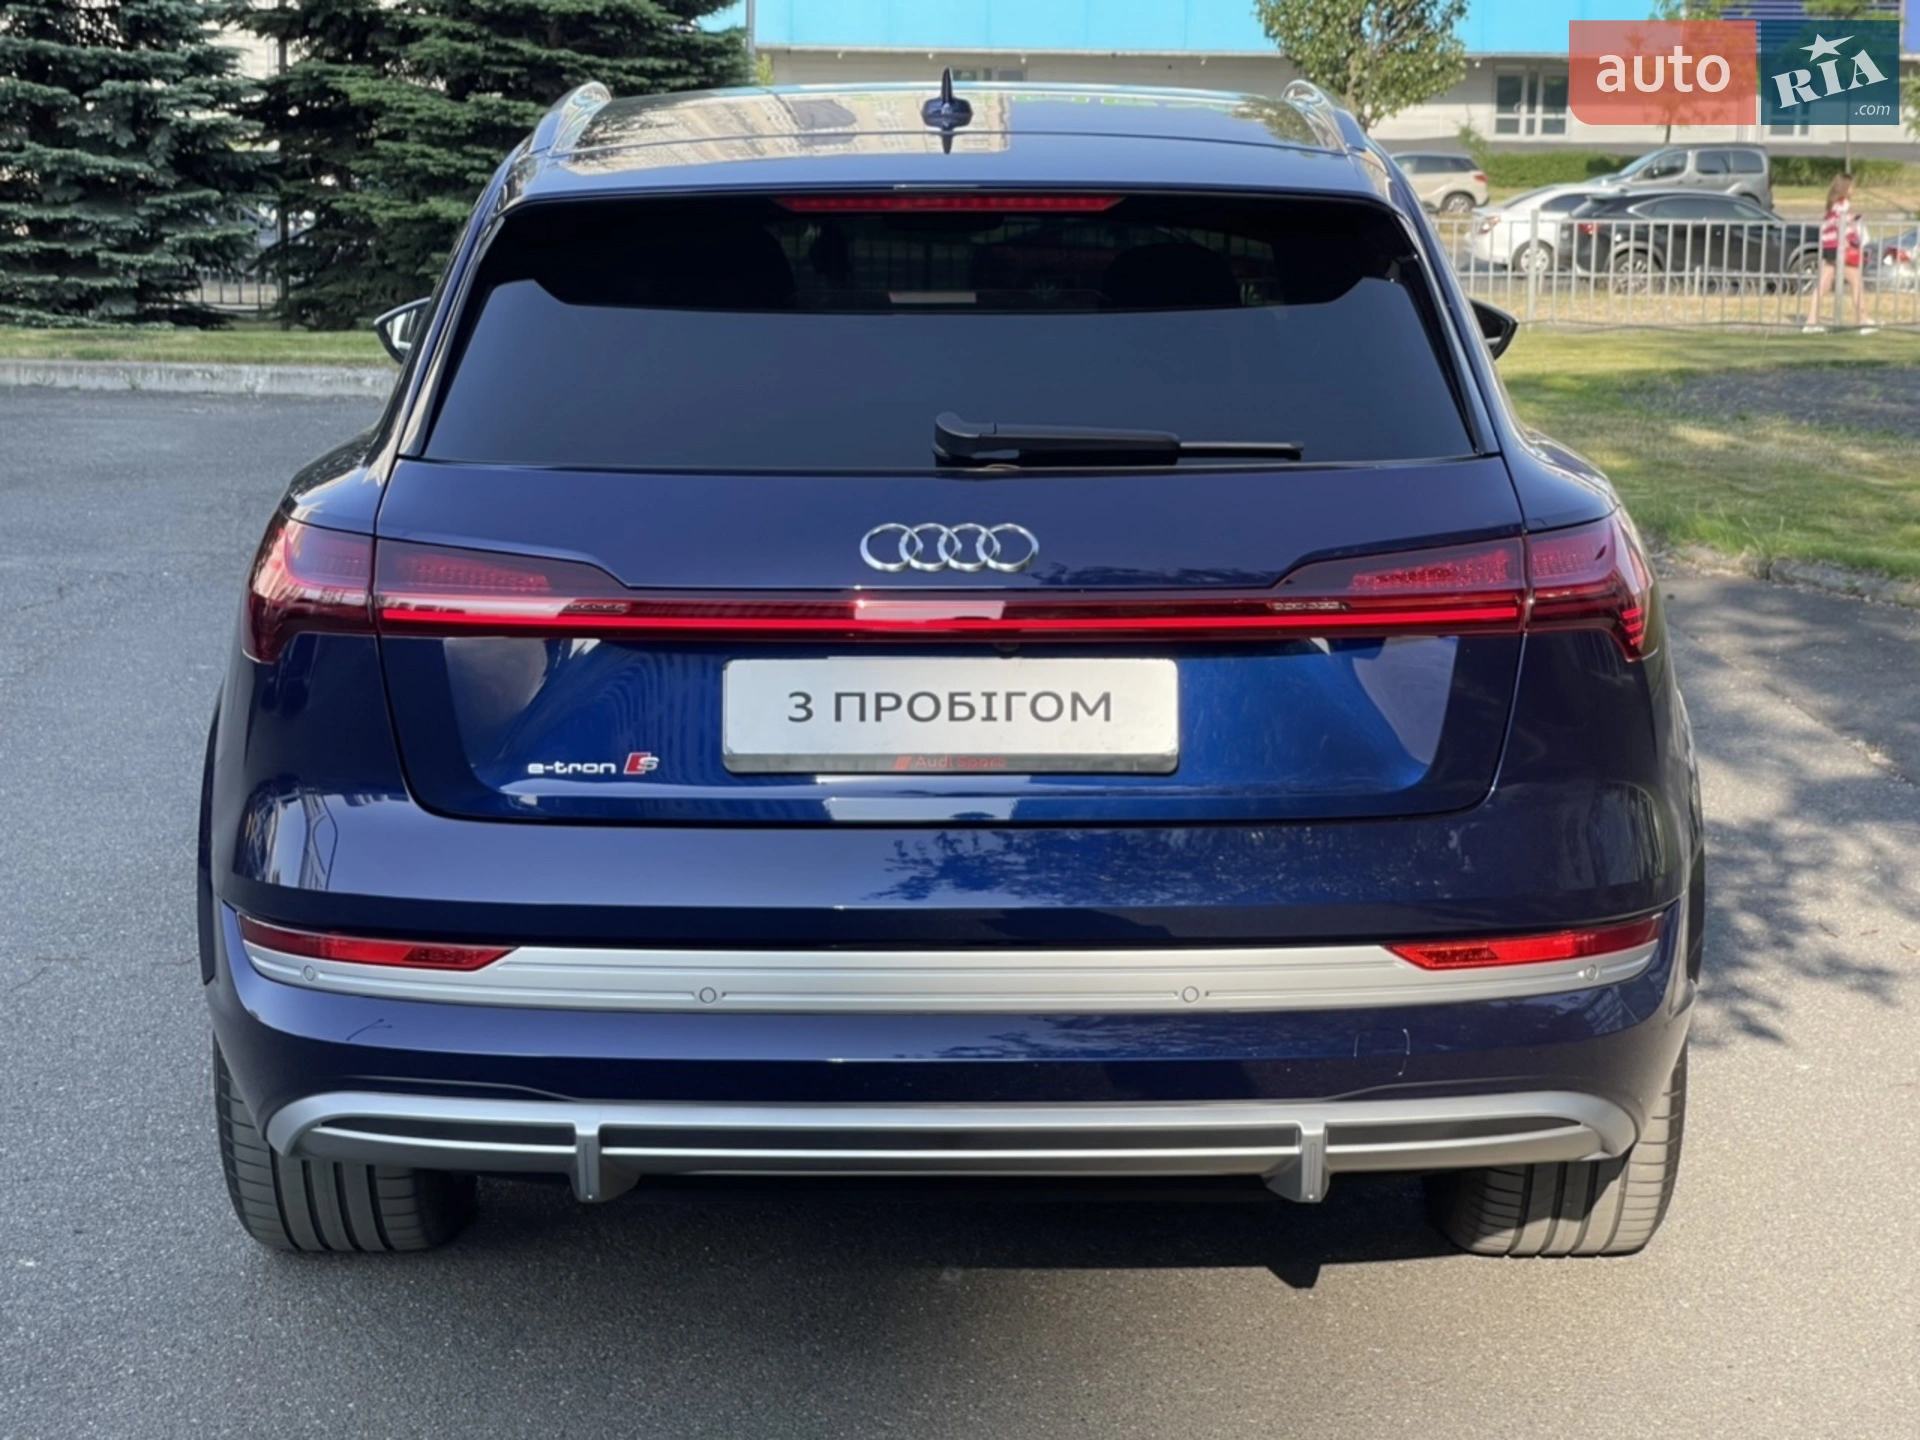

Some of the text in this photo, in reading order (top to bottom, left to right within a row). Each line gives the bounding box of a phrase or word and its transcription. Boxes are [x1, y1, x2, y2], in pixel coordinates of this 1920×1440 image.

[833, 691, 1112, 723] ПРОБІГОМ
[527, 760, 617, 775] e-tron
[915, 755, 952, 769] Audi
